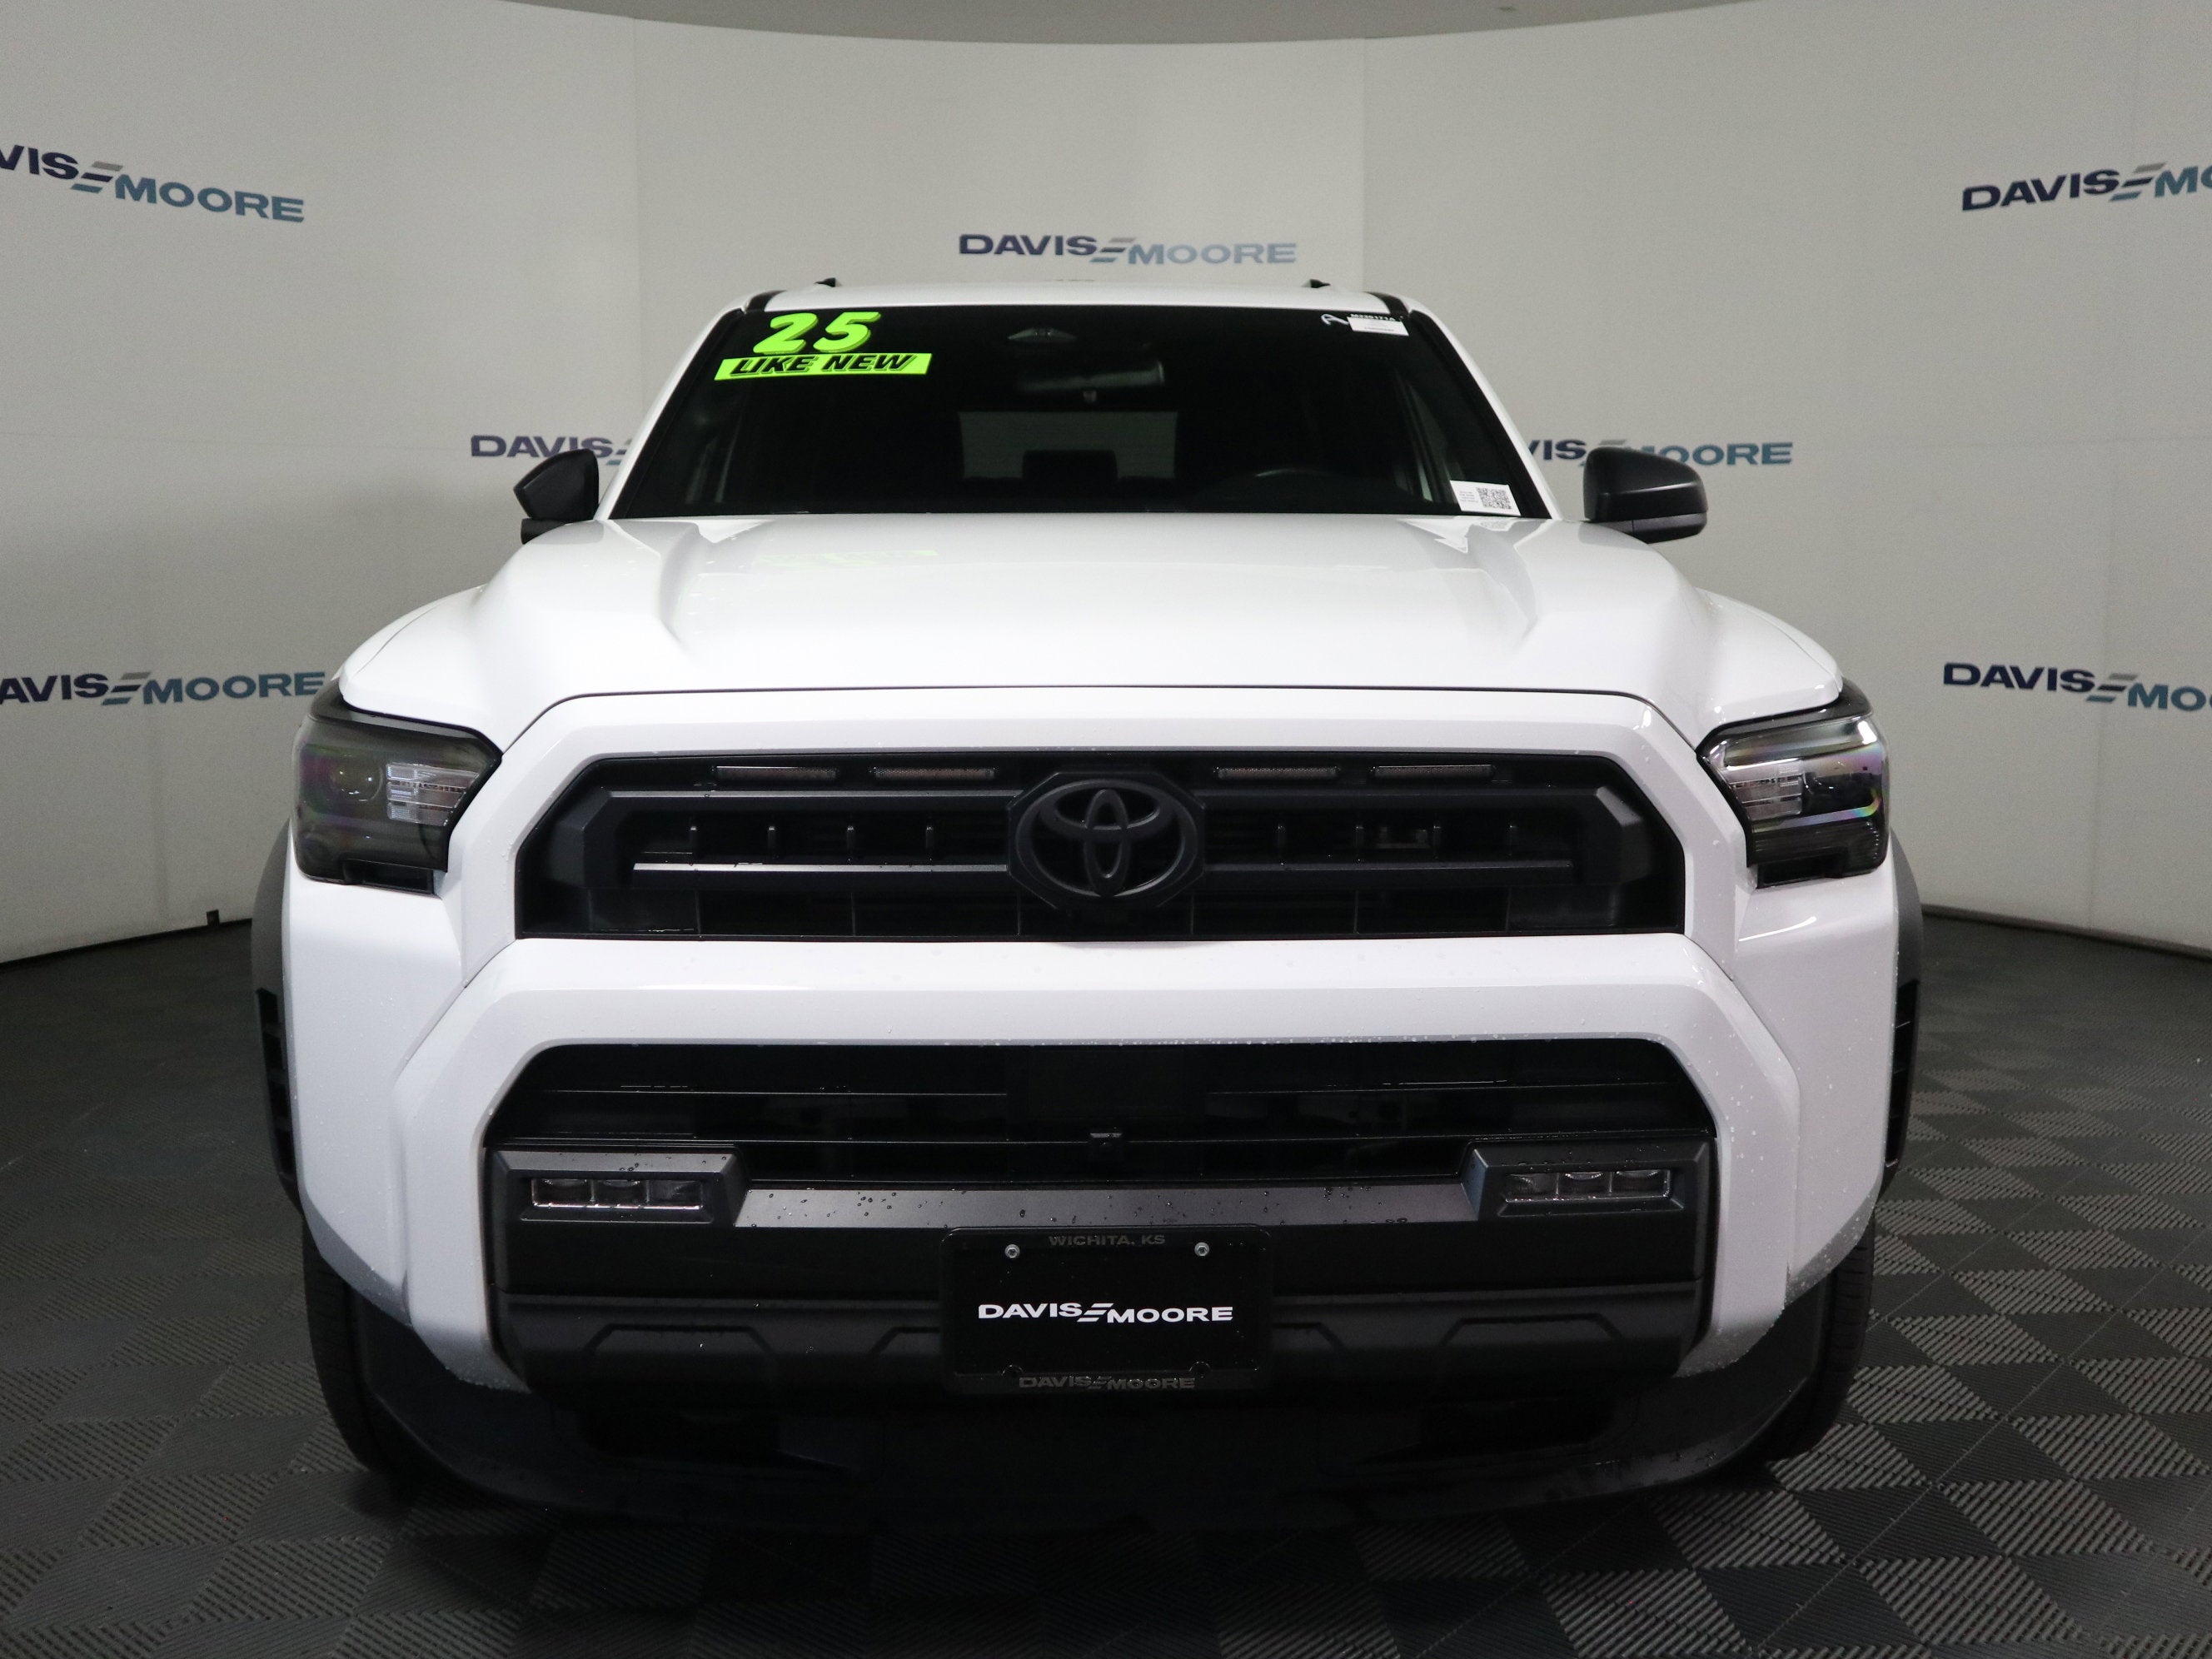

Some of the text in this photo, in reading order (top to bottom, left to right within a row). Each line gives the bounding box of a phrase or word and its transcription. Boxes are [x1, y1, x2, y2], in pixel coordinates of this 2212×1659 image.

[114, 173, 305, 223] MOORE
[1961, 168, 2120, 211] DAVIS
[959, 234, 1298, 266] DAVIS MOORE
[753, 311, 881, 354] 25
[730, 354, 917, 375] LIKE NEW
[471, 435, 613, 458] DAVIS
[1640, 441, 1794, 466] OORE
[142, 671, 326, 705] MOORE
[1943, 662, 2212, 712] DAVIS MO
[1141, 1234, 1166, 1245] KS
[978, 1303, 1233, 1323] DAVIS MOORE
[1019, 1375, 1196, 1390] DAVIS MOORE
